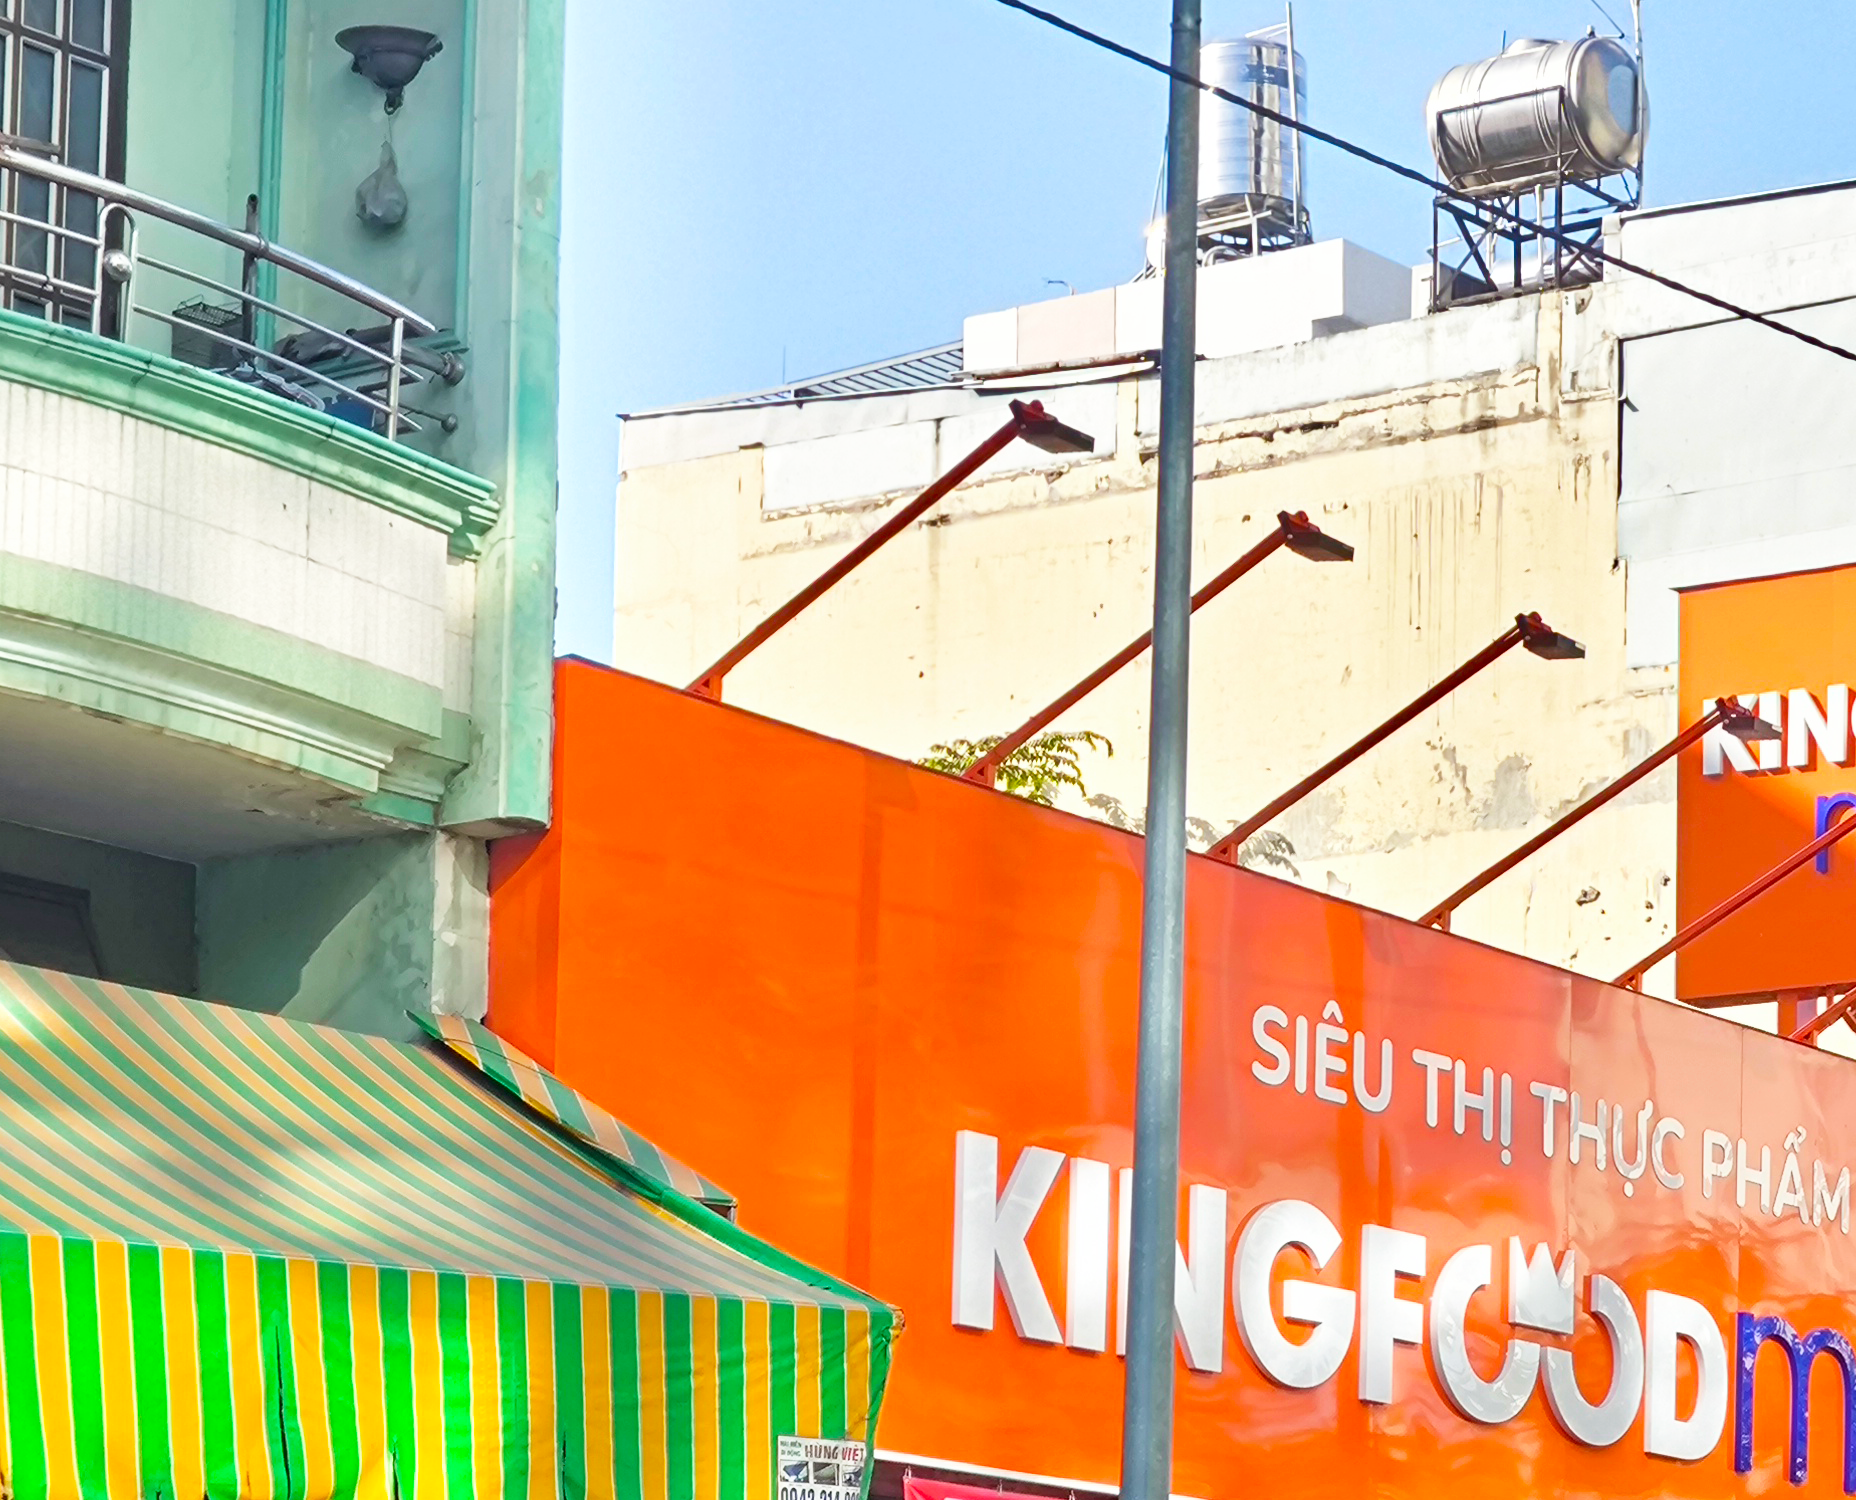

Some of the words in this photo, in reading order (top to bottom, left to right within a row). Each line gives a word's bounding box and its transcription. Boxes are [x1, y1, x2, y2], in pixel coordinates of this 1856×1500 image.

[1250, 1000, 1395, 1113] SIÊU
[1413, 1047, 1514, 1168] THỊ
[1531, 1080, 1685, 1199] THỰC
[1703, 1126, 1853, 1236] PHẨM
